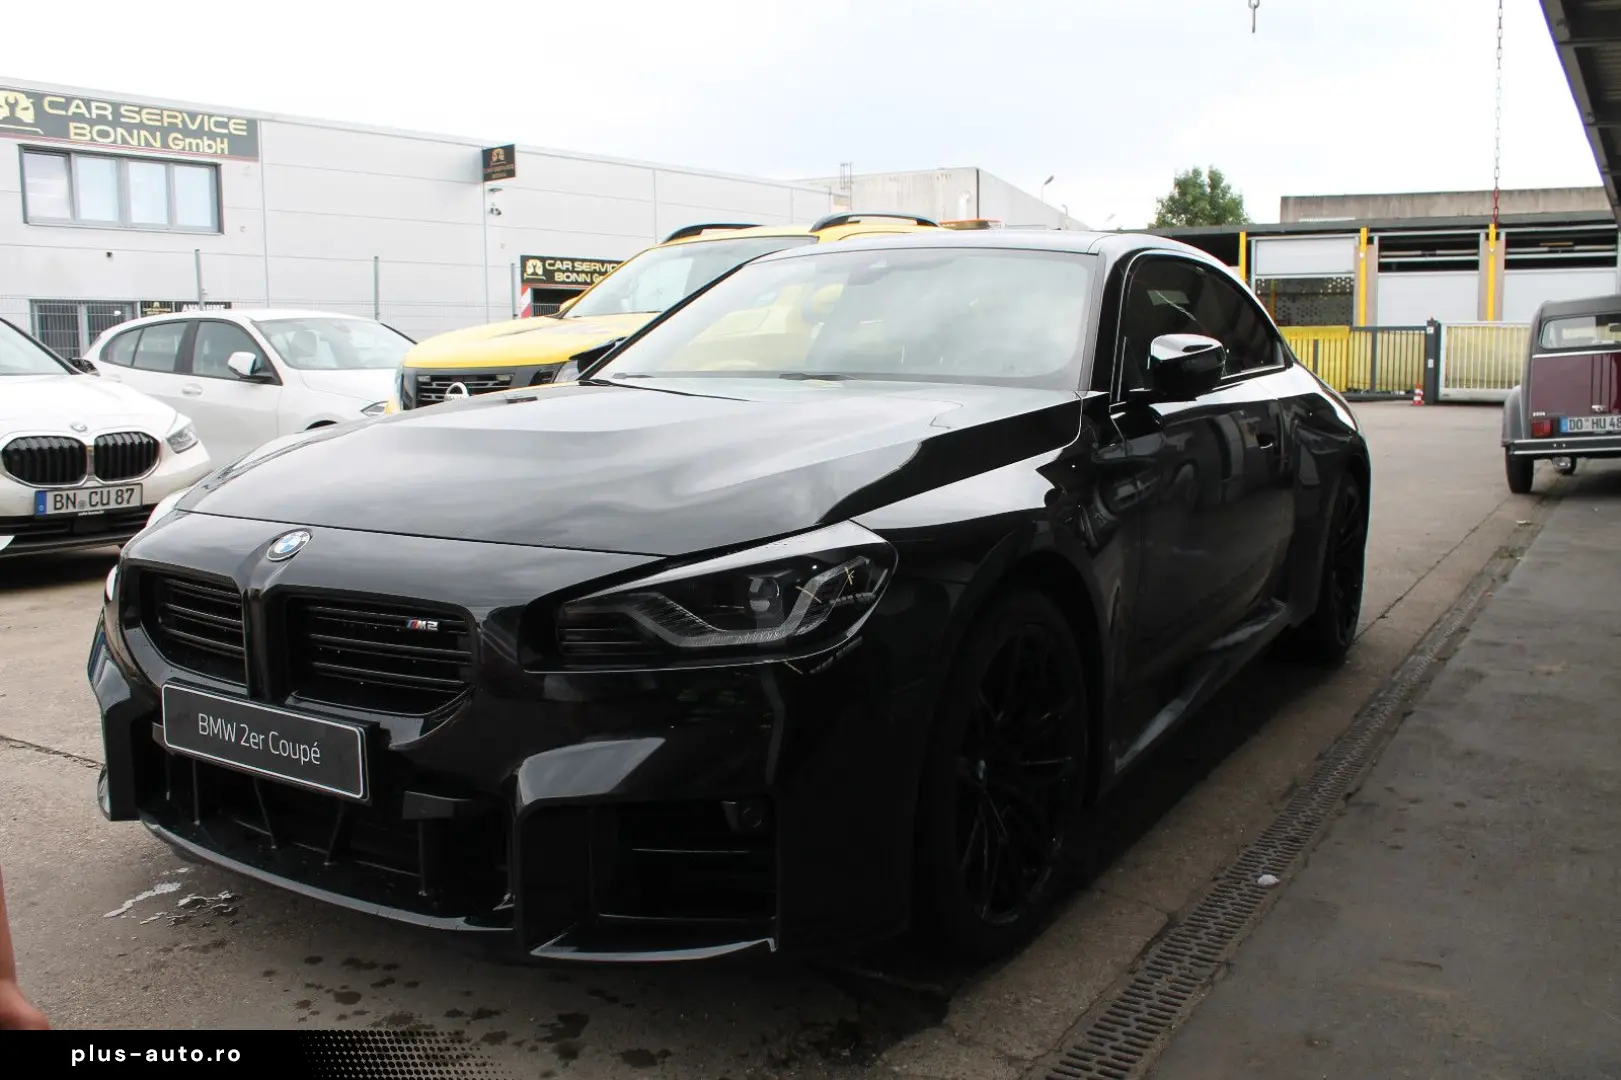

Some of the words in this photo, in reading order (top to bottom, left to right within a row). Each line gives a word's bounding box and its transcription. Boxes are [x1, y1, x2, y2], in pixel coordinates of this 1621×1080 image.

[43, 96, 112, 121] CAR
[120, 105, 248, 136] SERVICE
[69, 122, 162, 148] BONN
[168, 132, 229, 155] GmbH
[545, 260, 572, 271] CAR
[574, 261, 619, 273] SERVIC
[554, 272, 591, 283] BONN
[1569, 418, 1583, 431] DO
[1592, 417, 1607, 429] HU
[53, 492, 77, 511] BN
[89, 490, 111, 508] CU
[115, 487, 135, 505] 87
[198, 713, 236, 743] BMW
[240, 724, 265, 750] 2er
[268, 731, 321, 765] Coupé
